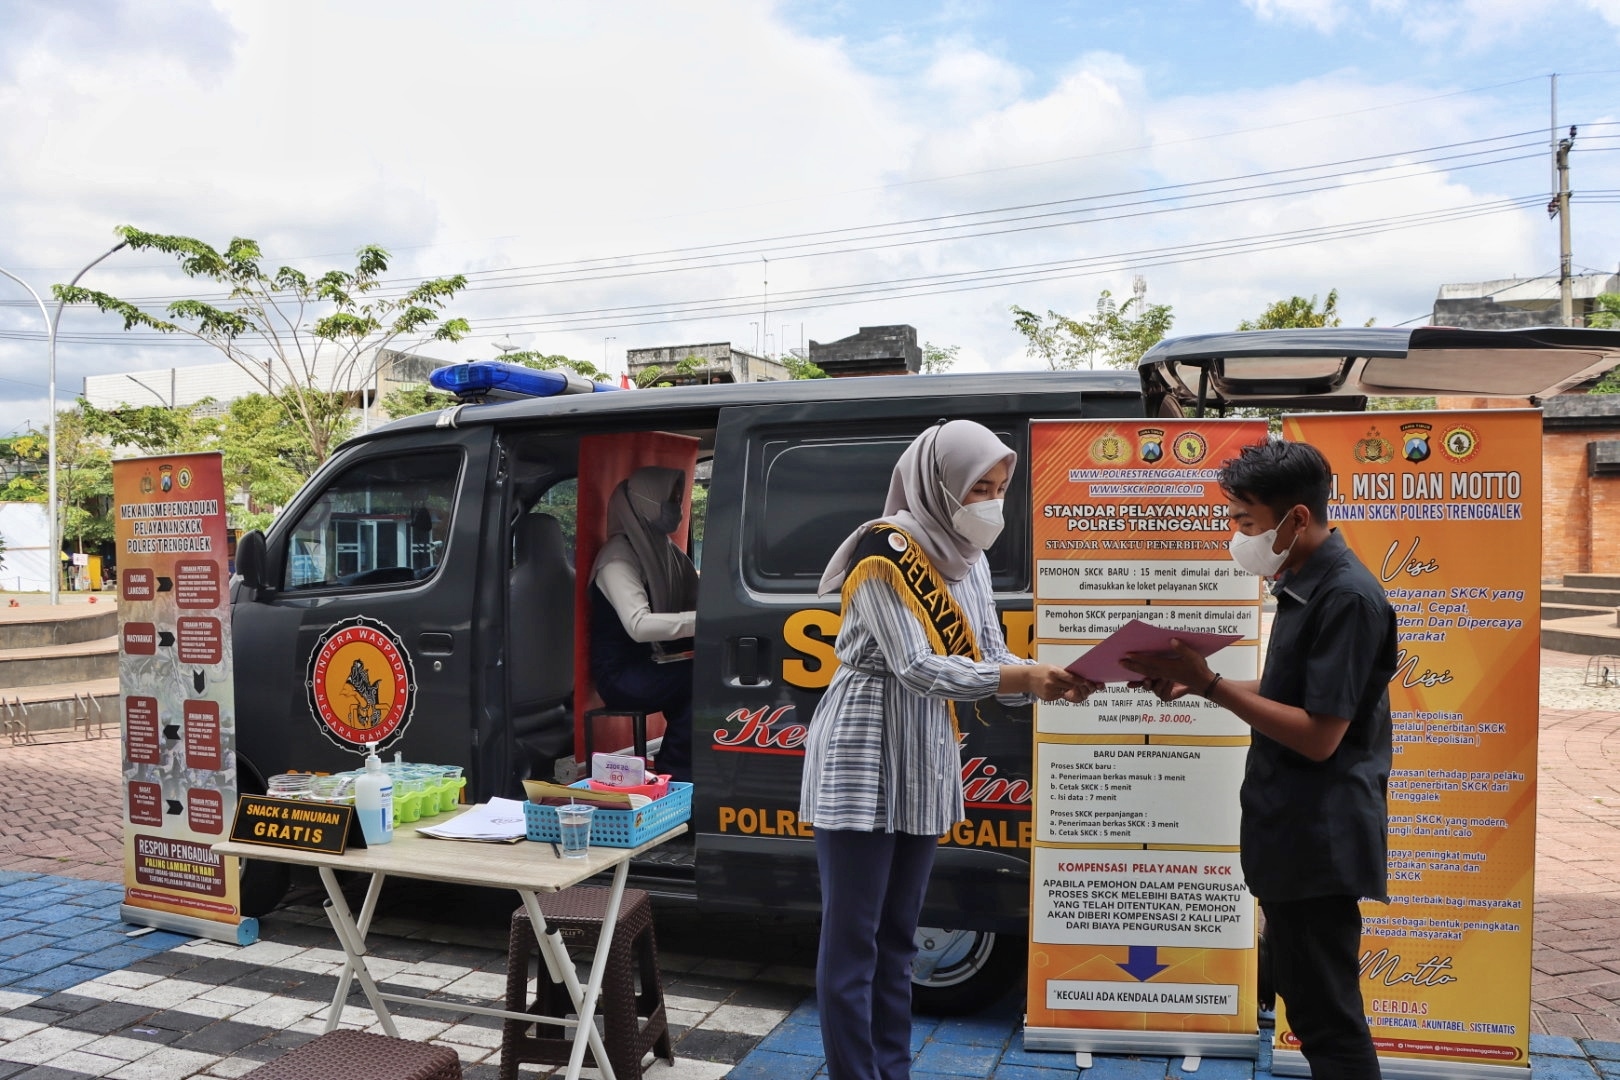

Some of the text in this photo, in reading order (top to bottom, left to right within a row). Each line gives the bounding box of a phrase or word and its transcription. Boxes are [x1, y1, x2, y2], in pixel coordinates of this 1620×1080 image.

[1352, 472, 1396, 500] MISI
[1401, 472, 1444, 500] DAN
[1451, 471, 1521, 500] MOTTO
[121, 500, 218, 519] MEKANISME PENGADUAN
[1044, 504, 1210, 518] STANDAR PELAYANAN
[1368, 504, 1398, 520] SKCK
[1400, 504, 1444, 520] POLRES
[1446, 504, 1521, 520] TRENGGALEK
[134, 519, 202, 536] PELAYANAN SKCK
[1068, 518, 1230, 532] POLRES TRENGGALEK
[128, 537, 211, 553] POLRES TRENGGALEK
[1046, 540, 1099, 550] STANDAR
[1102, 540, 1144, 550] WAKTU
[1146, 540, 1220, 550] PENERBITAN
[1380, 536, 1439, 582] Visi
[1040, 568, 1230, 577] PEMOHON SKCK BARU 15 menit dimulai dari
[1079, 582, 1218, 592] dimasukkan ke loket pelayanan SKCK
[1450, 588, 1524, 600] SKCK yang
[898, 547, 975, 657] PELAYAN
[1045, 610, 1252, 621] Pemohon SKCK perpanjangan 8 menit dimulai dari
[1059, 624, 1238, 634] berkas SKCK
[1428, 618, 1522, 630] Dan Dipercaya
[318, 630, 405, 682] INDERA WASPADA
[1156, 700, 1200, 708] PENERIMAAN
[318, 694, 404, 742] NEGARA RAHARJA
[1098, 714, 1196, 724] PAJAK (PNBP) Rp. 30.000,-
[1416, 711, 1463, 721] kepolisian
[1392, 722, 1506, 734] melalui penerbitan SKCK
[1425, 735, 1474, 744] Kepolisian
[1136, 750, 1200, 760] PERPANJANGAN
[1427, 770, 1524, 781] terhadap para pelaku
[1388, 780, 1509, 792] saat penerbitan SKCK dari
[1390, 790, 1440, 802] Trenggalek
[246, 804, 340, 826] SNACK & MINUMAN
[1094, 810, 1144, 818] perpanjangan
[1416, 814, 1509, 829] SKCK yang modern,
[254, 821, 324, 844] GRATIS
[1414, 826, 1472, 837] dan anti calo
[139, 840, 169, 858] RESPON
[1414, 850, 1460, 860] peningkat
[1462, 852, 1486, 861] mutu
[166, 860, 191, 873] LAMBAT
[1058, 862, 1232, 876] KOMPENSASI PELAYANAN SKCK
[1429, 864, 1480, 872] sarana dan
[1395, 871, 1422, 880] SKCK
[1043, 880, 1247, 892] APABILA PEMOHON DALAM PENGURUSAN
[1048, 890, 1241, 902] PROSES SKCK MELEBIHI BATAS WAKTU
[1053, 900, 1236, 912] YANG TELAH DITENTUKAN, PEMOHON
[1389, 896, 1410, 905] yang
[1412, 896, 1443, 904] terbaik
[1446, 896, 1466, 908] bagi
[1468, 898, 1522, 909] masyarakat
[1047, 911, 1242, 923] AKAN DIBERI KOMPENSASI 2 KALI LIPAT
[1066, 922, 1222, 933] DARI BIAYA PENGURUSAN SKCK
[1392, 916, 1520, 932] sebagai bentuk peningkatan
[1375, 928, 1463, 940] kepada masyarakat
[1358, 948, 1458, 987] Motto
[1096, 992, 1115, 1002] ADA
[1117, 992, 1158, 1004] KENDALA
[1161, 994, 1194, 1004] DALAM
[1372, 1000, 1429, 1015] C.E.R.D.A.S
[1469, 1022, 1516, 1035] SISTEMATIS
